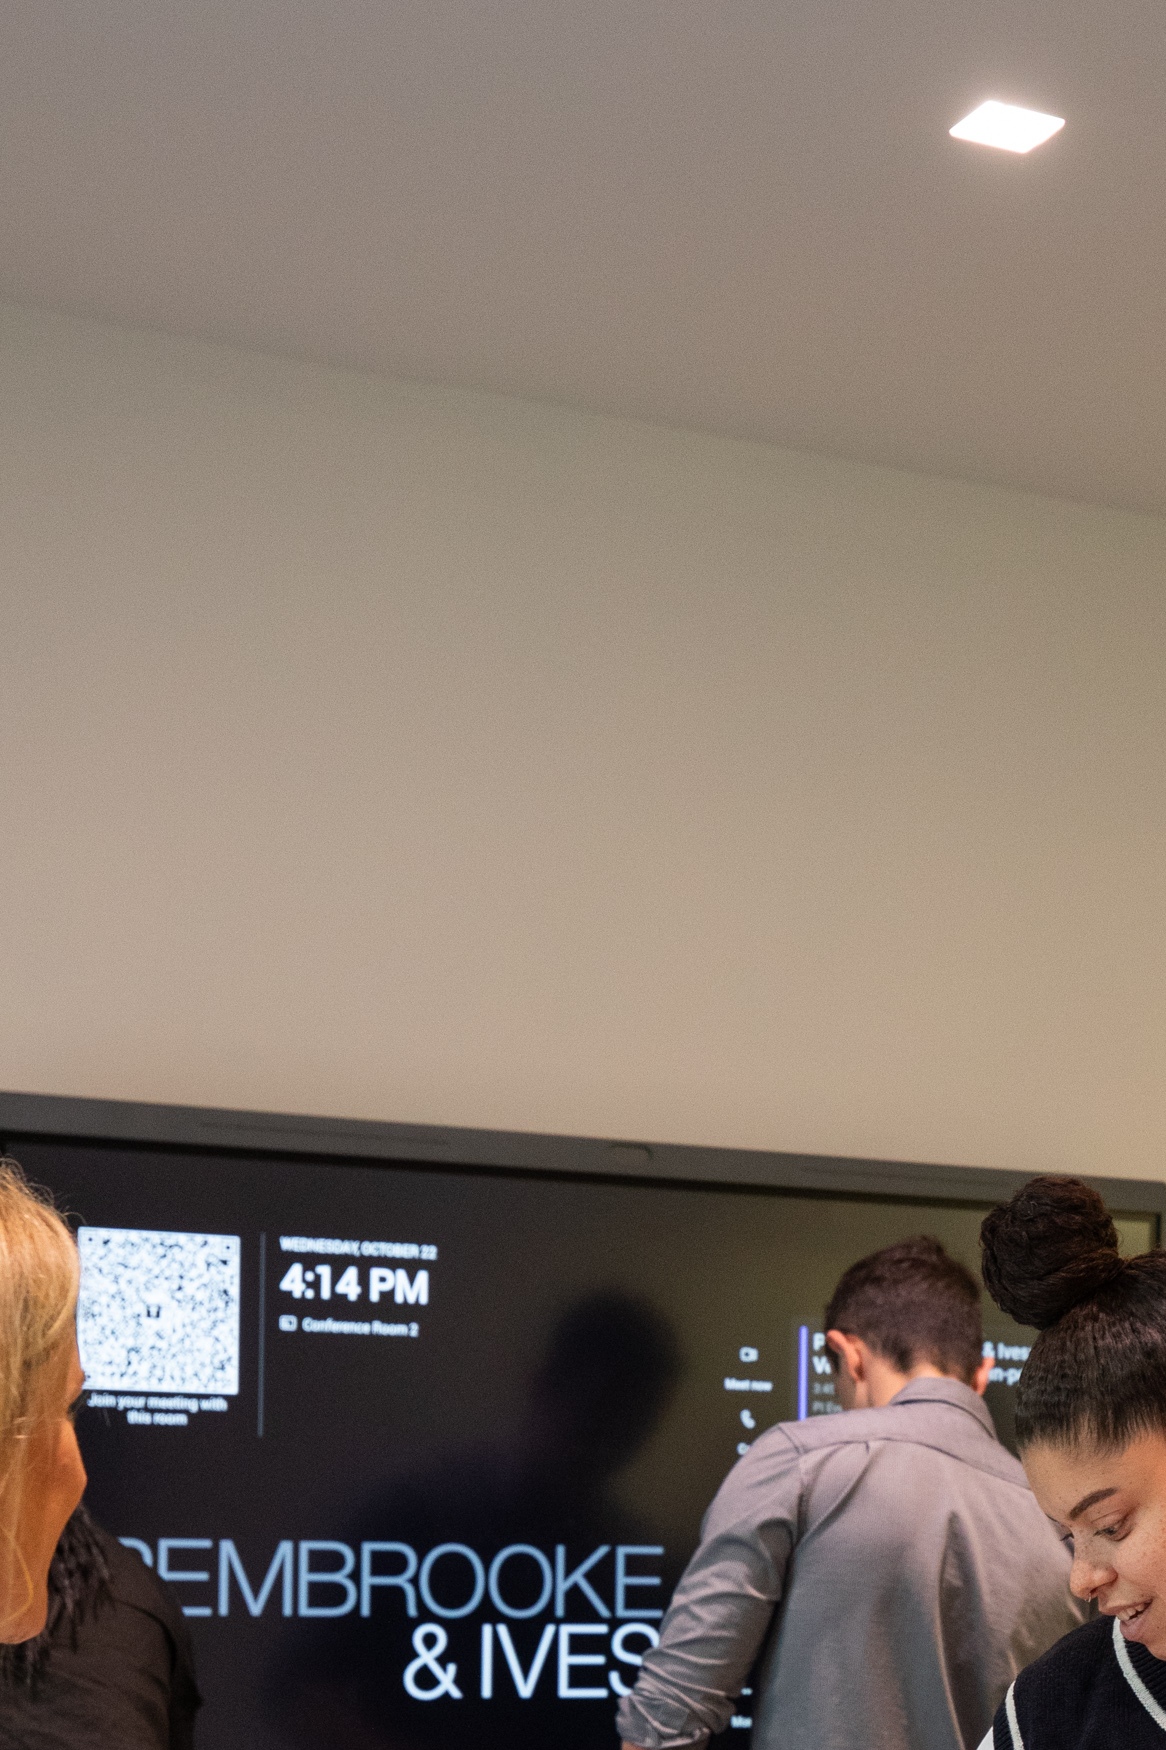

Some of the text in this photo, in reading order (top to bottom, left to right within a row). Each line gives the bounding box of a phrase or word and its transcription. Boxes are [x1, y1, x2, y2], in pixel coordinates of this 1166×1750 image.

[361, 1240, 419, 1259] OCTOBER
[420, 1244, 438, 1260] 22
[279, 1262, 429, 1306] 4:14 PM
[302, 1317, 419, 1338] Conference Room 2
[86, 1392, 228, 1413] Join your meeting with
[126, 1409, 188, 1426] this room
[403, 1622, 660, 1701] & IVES
